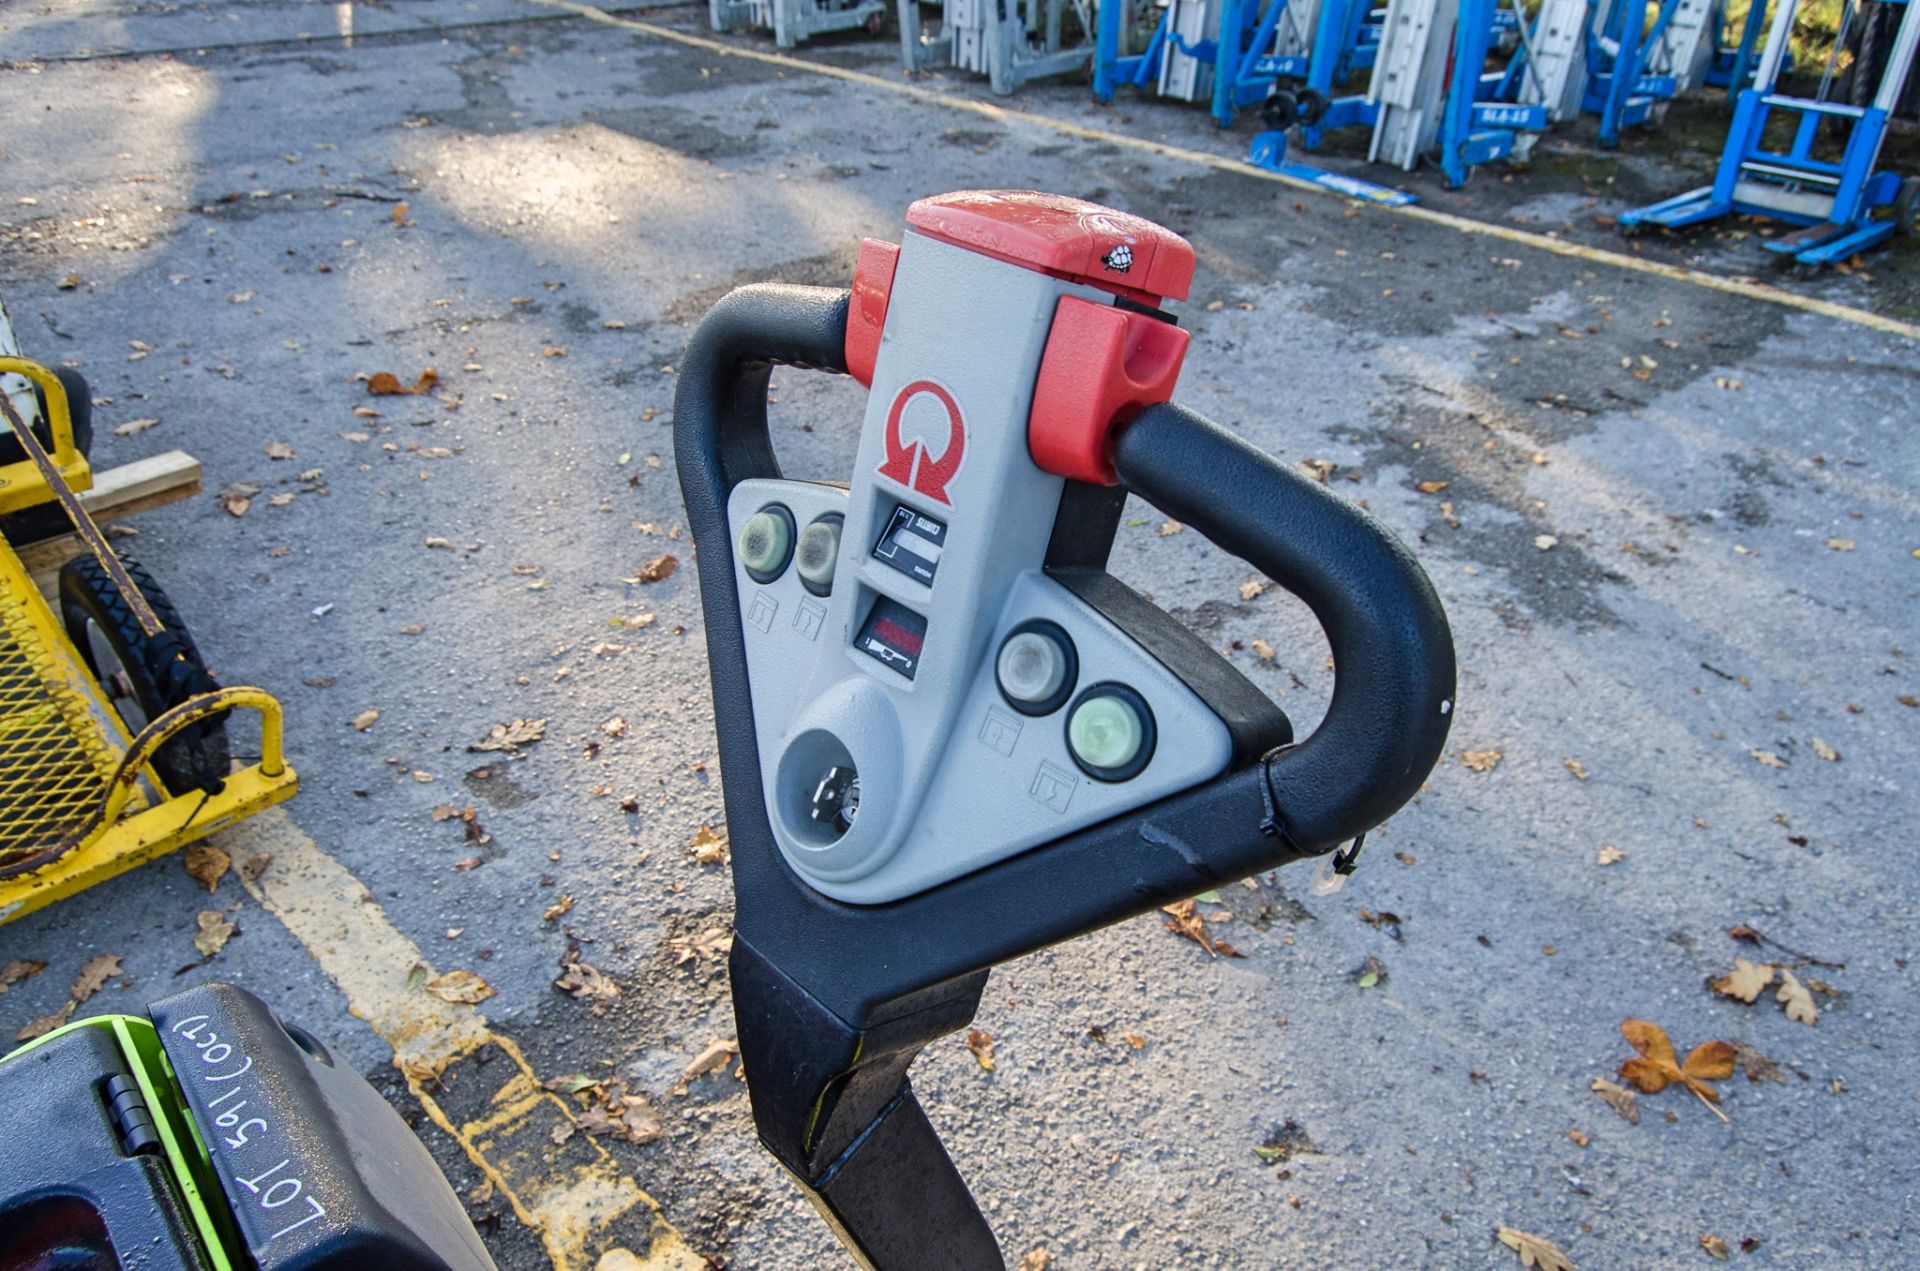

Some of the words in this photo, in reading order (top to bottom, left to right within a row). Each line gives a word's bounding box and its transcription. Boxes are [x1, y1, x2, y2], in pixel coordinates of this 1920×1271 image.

[915, 516, 940, 536] CURTIS
[913, 565, 932, 579] HOURS
[172, 1015, 252, 1081] (OCT)
[208, 1086, 268, 1149] 591
[235, 1159, 326, 1240] LOT
